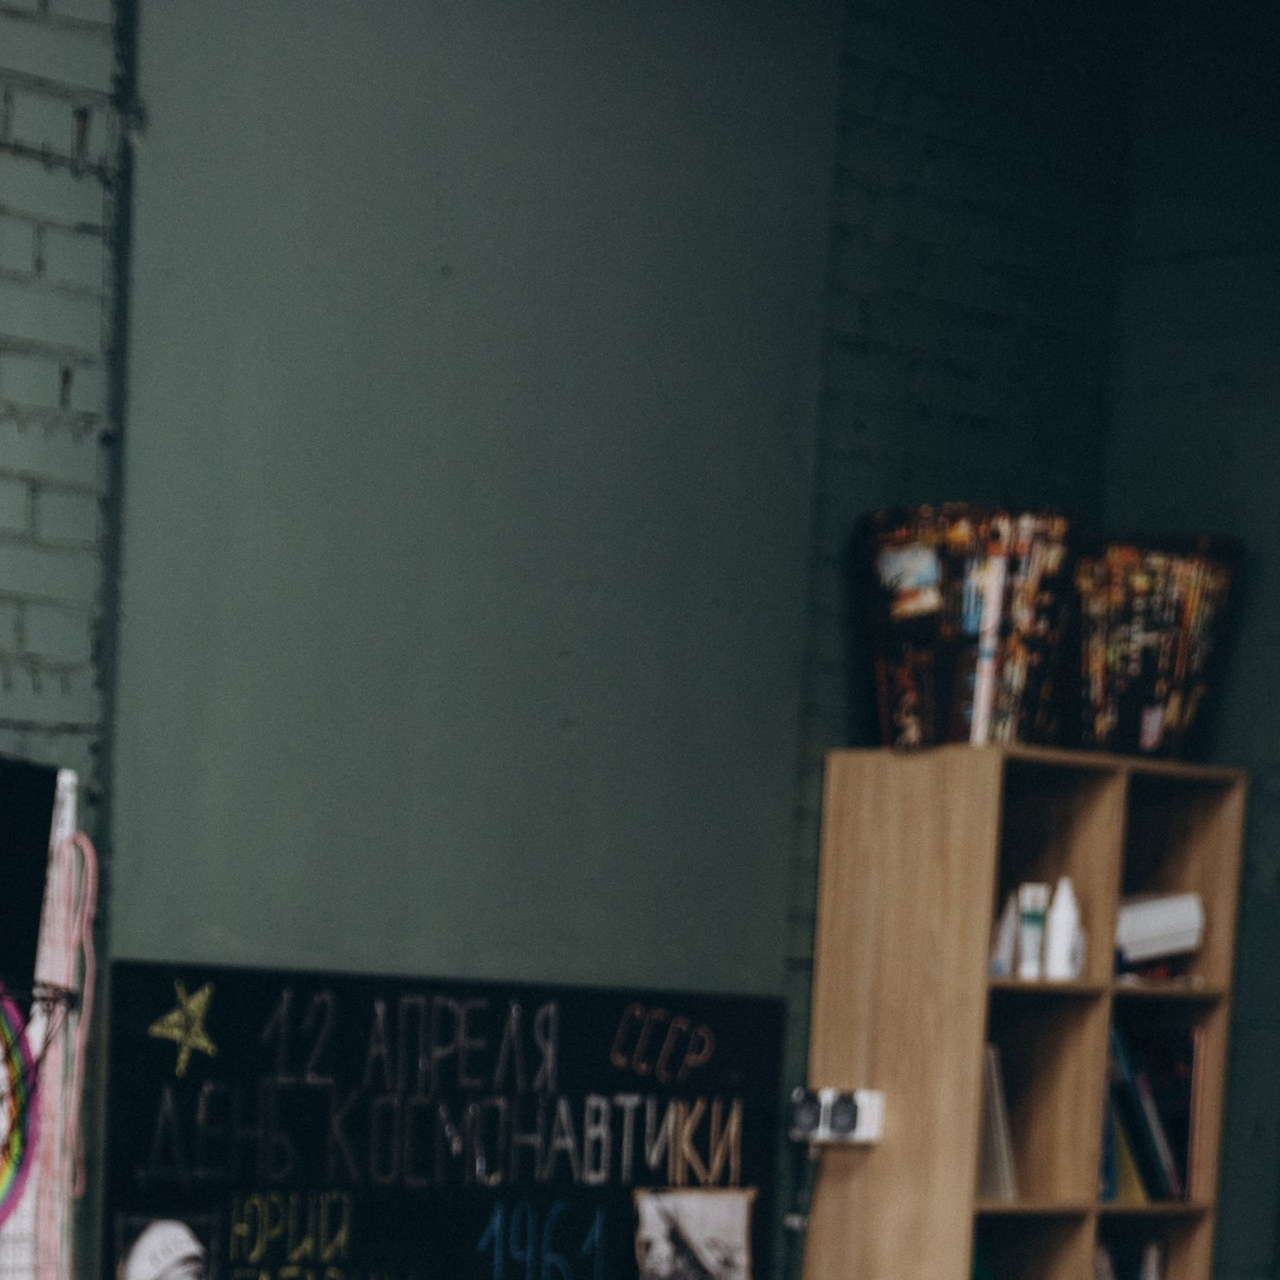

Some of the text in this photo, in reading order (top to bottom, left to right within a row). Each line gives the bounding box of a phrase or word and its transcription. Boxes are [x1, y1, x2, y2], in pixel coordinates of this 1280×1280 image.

[259, 986, 717, 1092] 12 АПРЕЛЯ СССР
[134, 1082, 744, 1189] ДЕНЬ КОСМОНАВТИКИ
